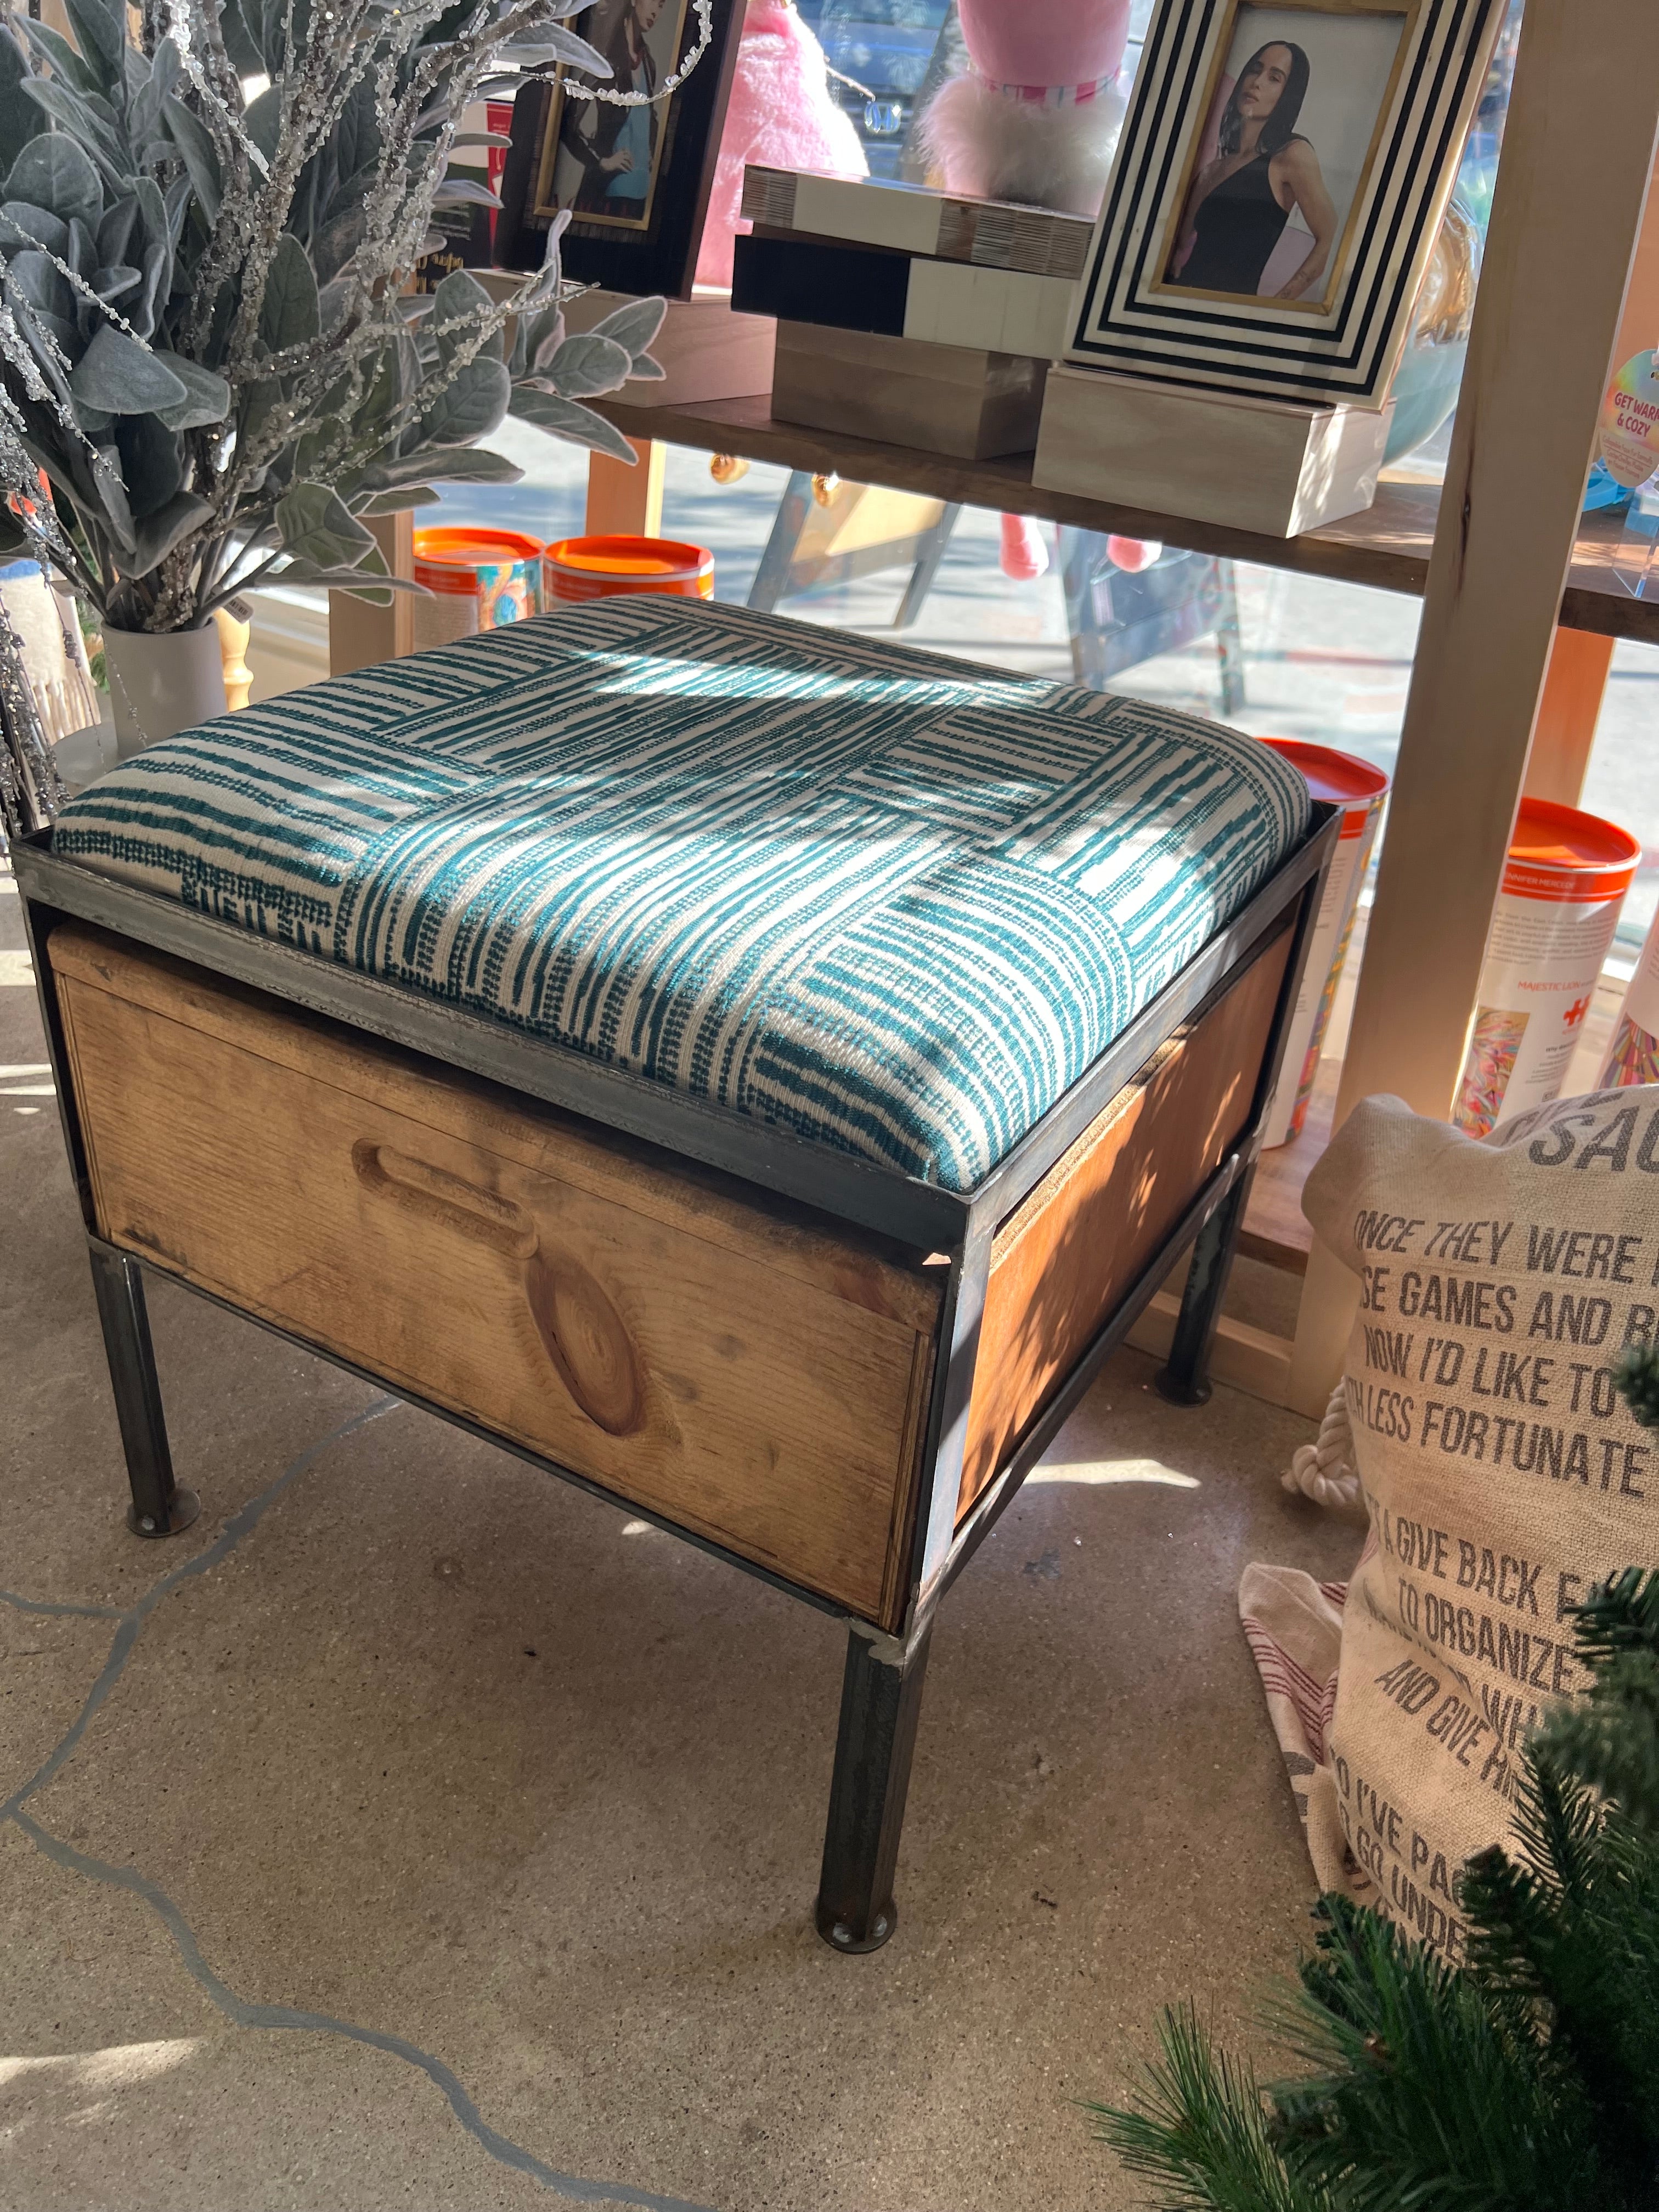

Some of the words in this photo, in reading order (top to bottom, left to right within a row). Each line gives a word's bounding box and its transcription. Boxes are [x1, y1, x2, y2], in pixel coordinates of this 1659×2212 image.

[1615, 392, 1634, 410] GET
[1617, 413, 1624, 427] &
[1626, 416, 1651, 437] COZY
[1518, 981, 1559, 992] MAJESTIC
[1354, 1210, 1425, 1253] ONCE
[1424, 1221, 1515, 1265] THEY
[1527, 1224, 1643, 1284] WERE
[1399, 1271, 1517, 1334] GAMES
[1528, 1291, 1612, 1346] AND
[1363, 1324, 1414, 1379] NOW
[1419, 1336, 1465, 1387] I'D
[1472, 1347, 1554, 1407] LIKE
[1568, 1362, 1616, 1418] TO
[1367, 1385, 1414, 1443] LESS
[1420, 1400, 1651, 1498] FORTUNATE
[1397, 1516, 1448, 1579] GIVE
[1457, 1538, 1542, 1617] BACK
[1398, 1576, 1419, 1632] TO
[1424, 1592, 1578, 1696] ORGANIZE
[1374, 1658, 1440, 1716] AND
[1426, 1695, 1491, 1767] GIVE
[1357, 1776, 1403, 1857] I'VE
